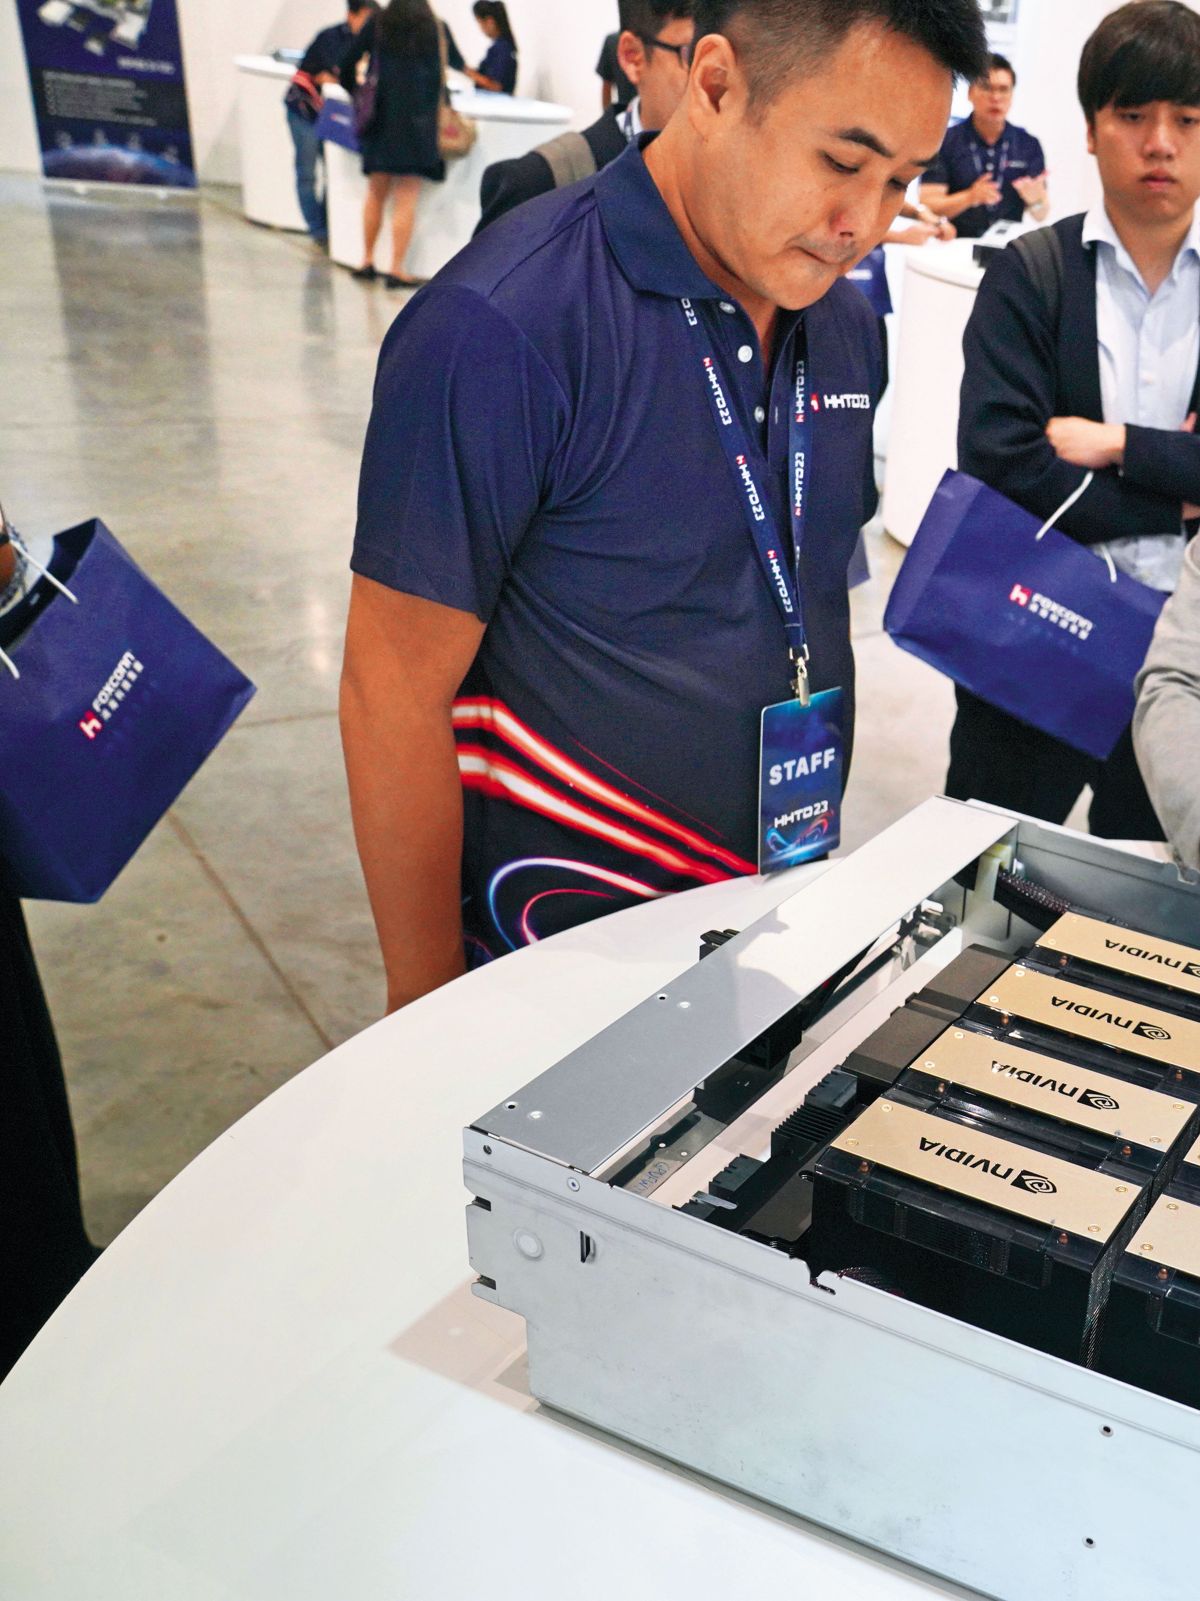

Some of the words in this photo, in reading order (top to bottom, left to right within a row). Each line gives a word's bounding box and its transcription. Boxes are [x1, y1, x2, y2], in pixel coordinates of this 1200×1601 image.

[769, 747, 836, 786] STAFF
[1104, 938, 1182, 969] NVIDIA
[1051, 995, 1133, 1030] NVIDIA
[991, 1060, 1081, 1098] NVIDIA
[919, 1136, 1014, 1179] NVIDIA
